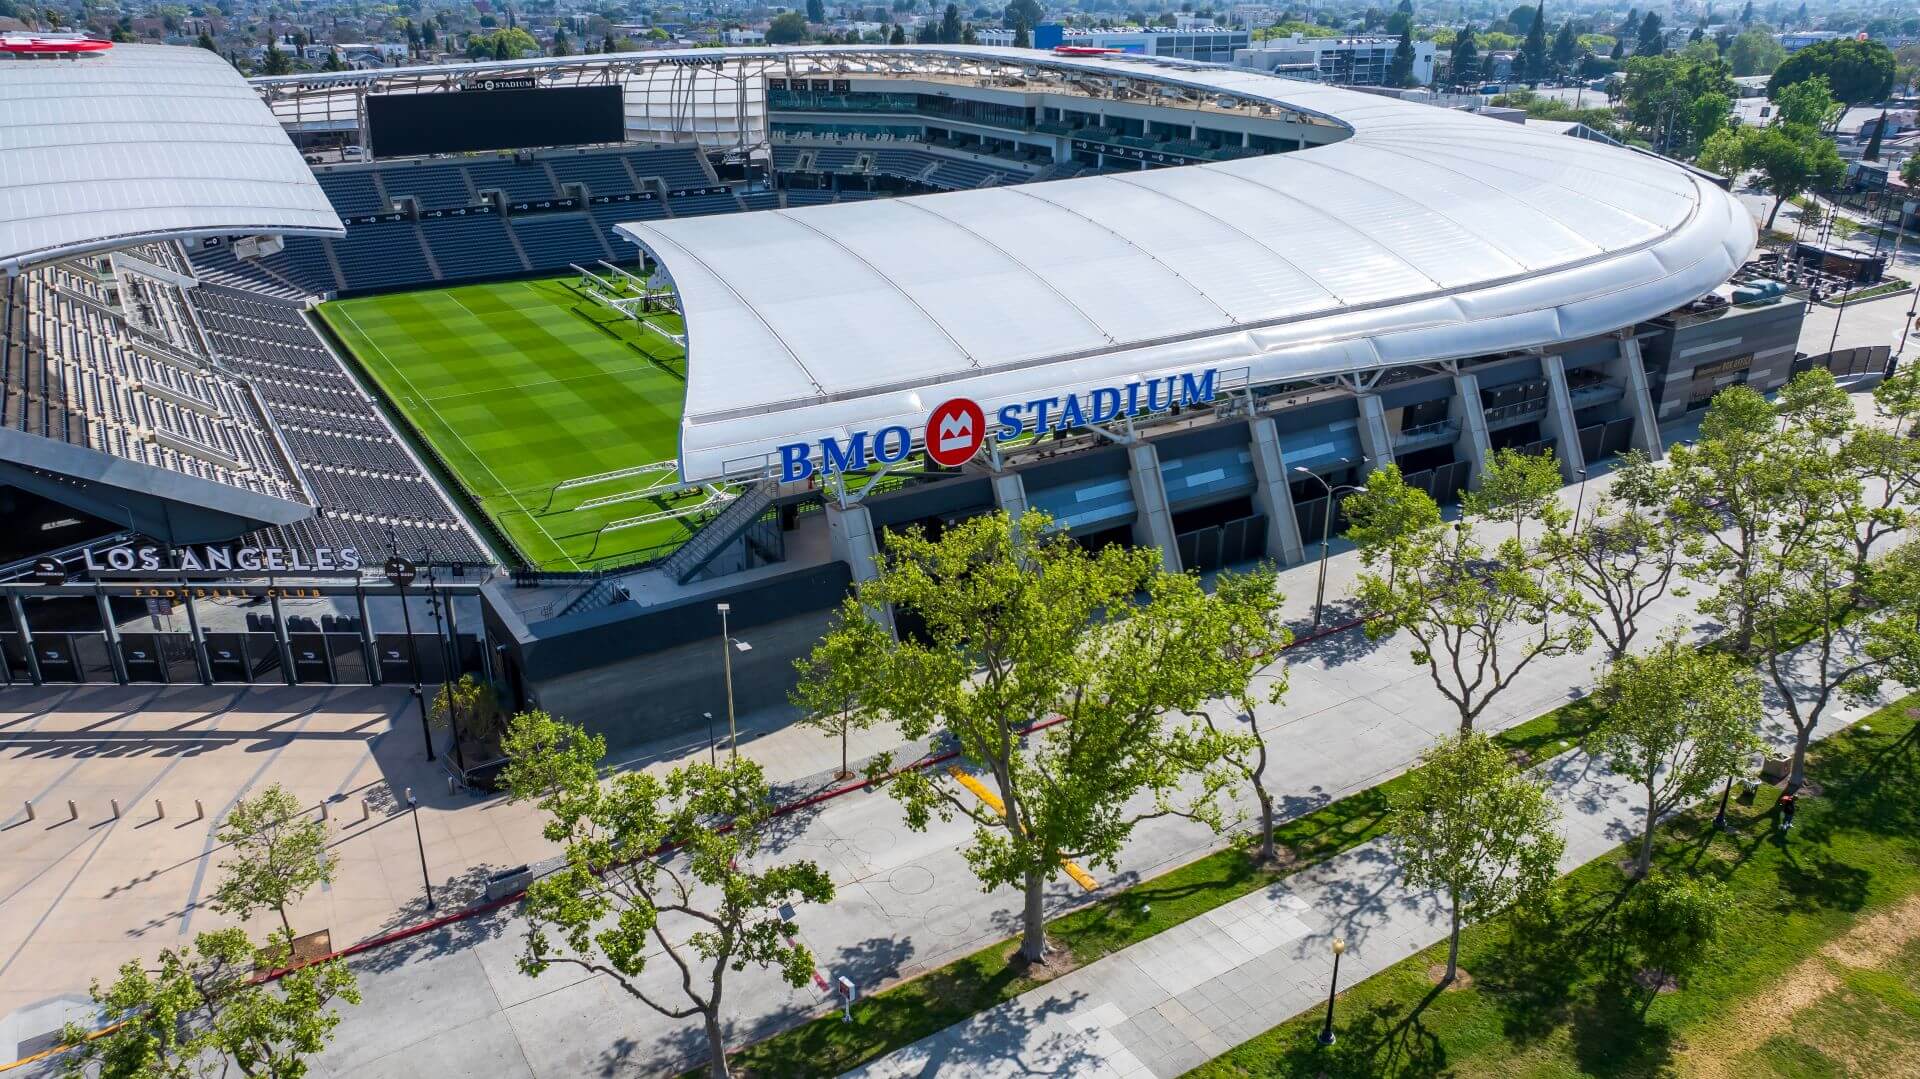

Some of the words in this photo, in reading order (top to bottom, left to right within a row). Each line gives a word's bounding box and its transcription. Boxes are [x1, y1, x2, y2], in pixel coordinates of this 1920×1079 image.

[776, 424, 911, 484] BMO
[997, 368, 1218, 441] STADIUM
[83, 547, 160, 571] LOS
[181, 546, 360, 571] ANGELES
[134, 589, 249, 598] FOOTBALL
[267, 589, 321, 598] CLUB
